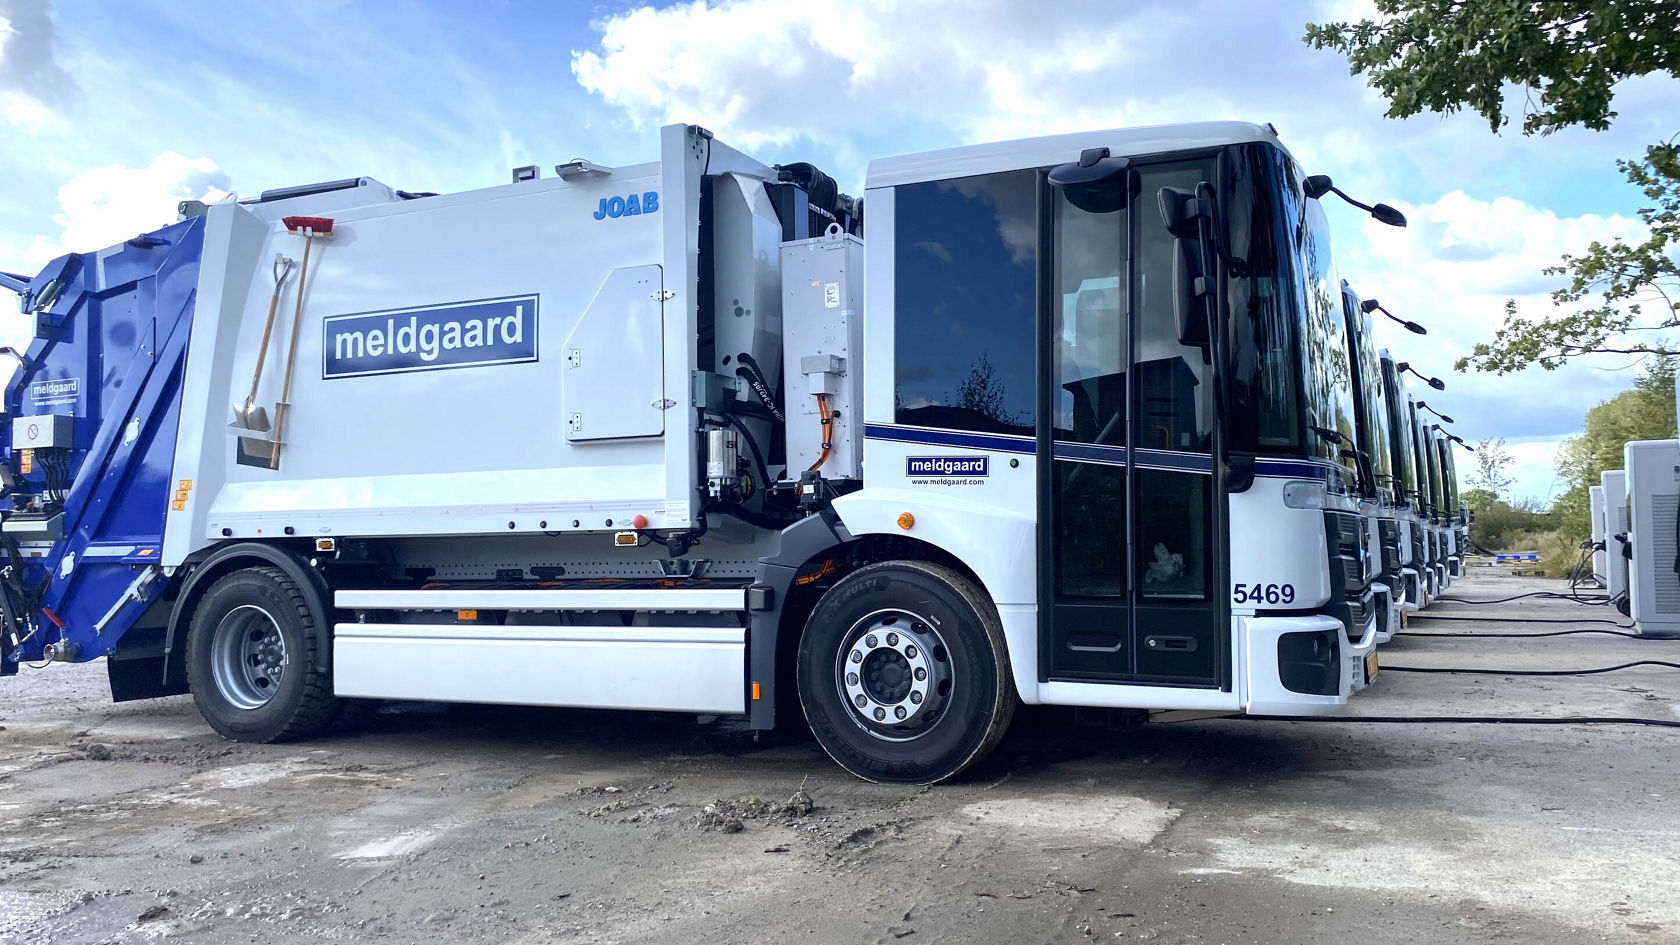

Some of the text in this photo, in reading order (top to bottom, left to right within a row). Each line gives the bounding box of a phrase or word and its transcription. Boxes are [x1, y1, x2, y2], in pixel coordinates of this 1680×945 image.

[593, 191, 659, 221] JOAB
[335, 305, 523, 362] meldgaard
[33, 380, 77, 396] meldgaard
[911, 458, 984, 474] meldgaard
[911, 478, 985, 487] www.meldgaard.com
[1233, 583, 1295, 605] 5469
